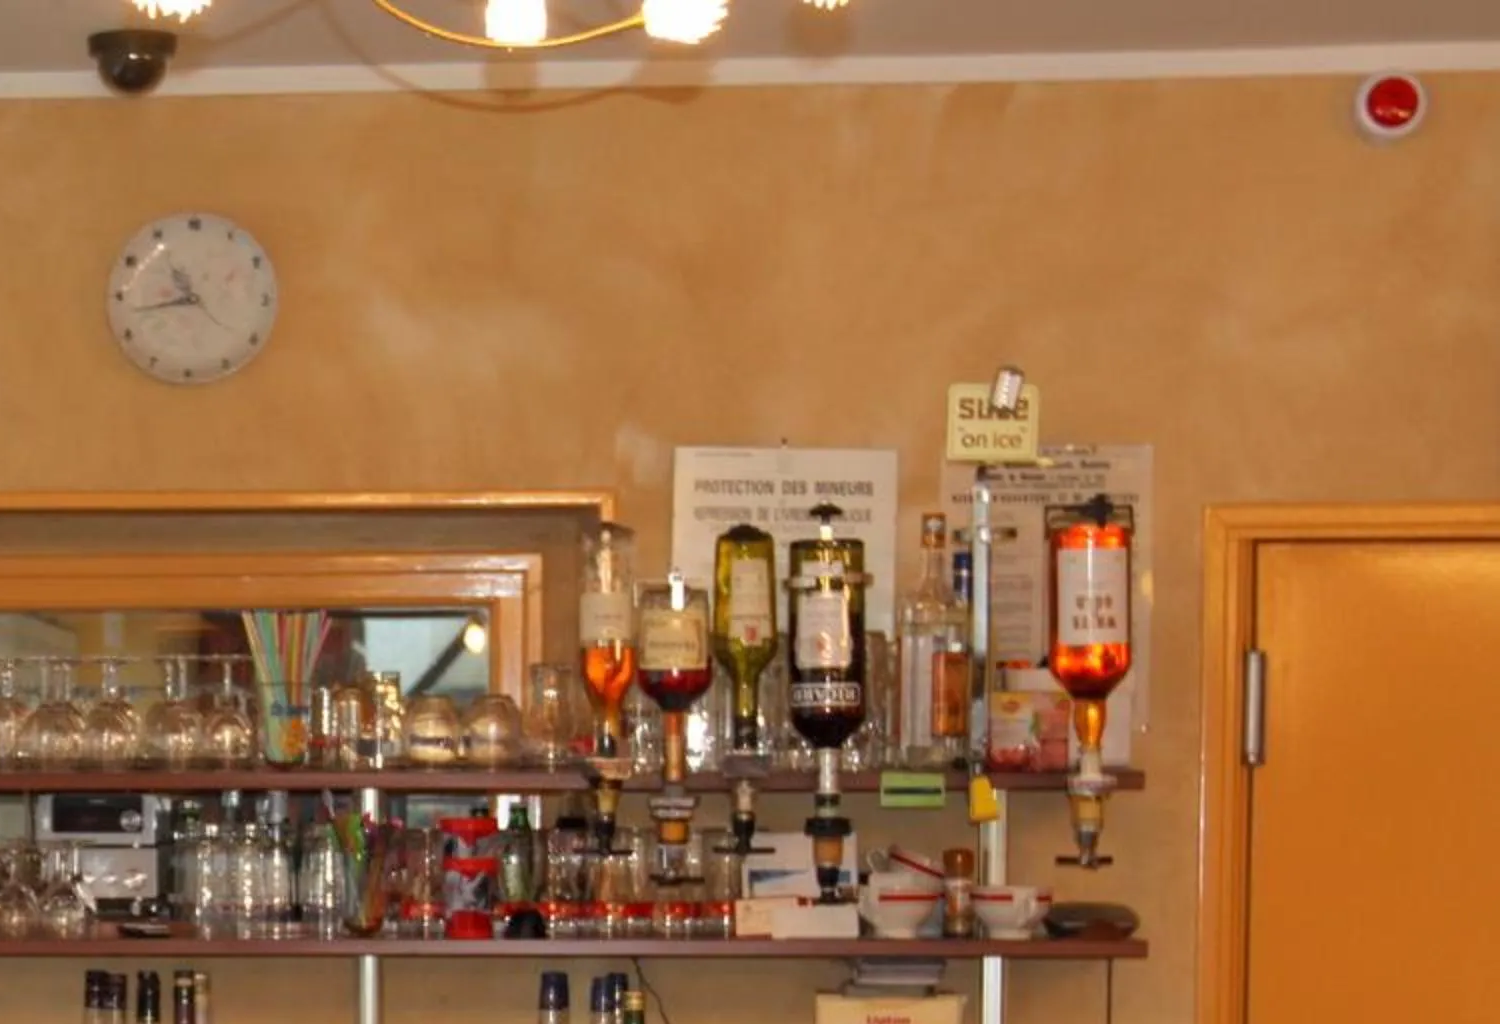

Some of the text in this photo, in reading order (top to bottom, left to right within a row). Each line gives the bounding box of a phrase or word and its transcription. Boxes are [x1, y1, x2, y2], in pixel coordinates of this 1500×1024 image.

[958, 397, 1029, 421] sue
[694, 479, 874, 497] PROTECTION DES MINEURS
